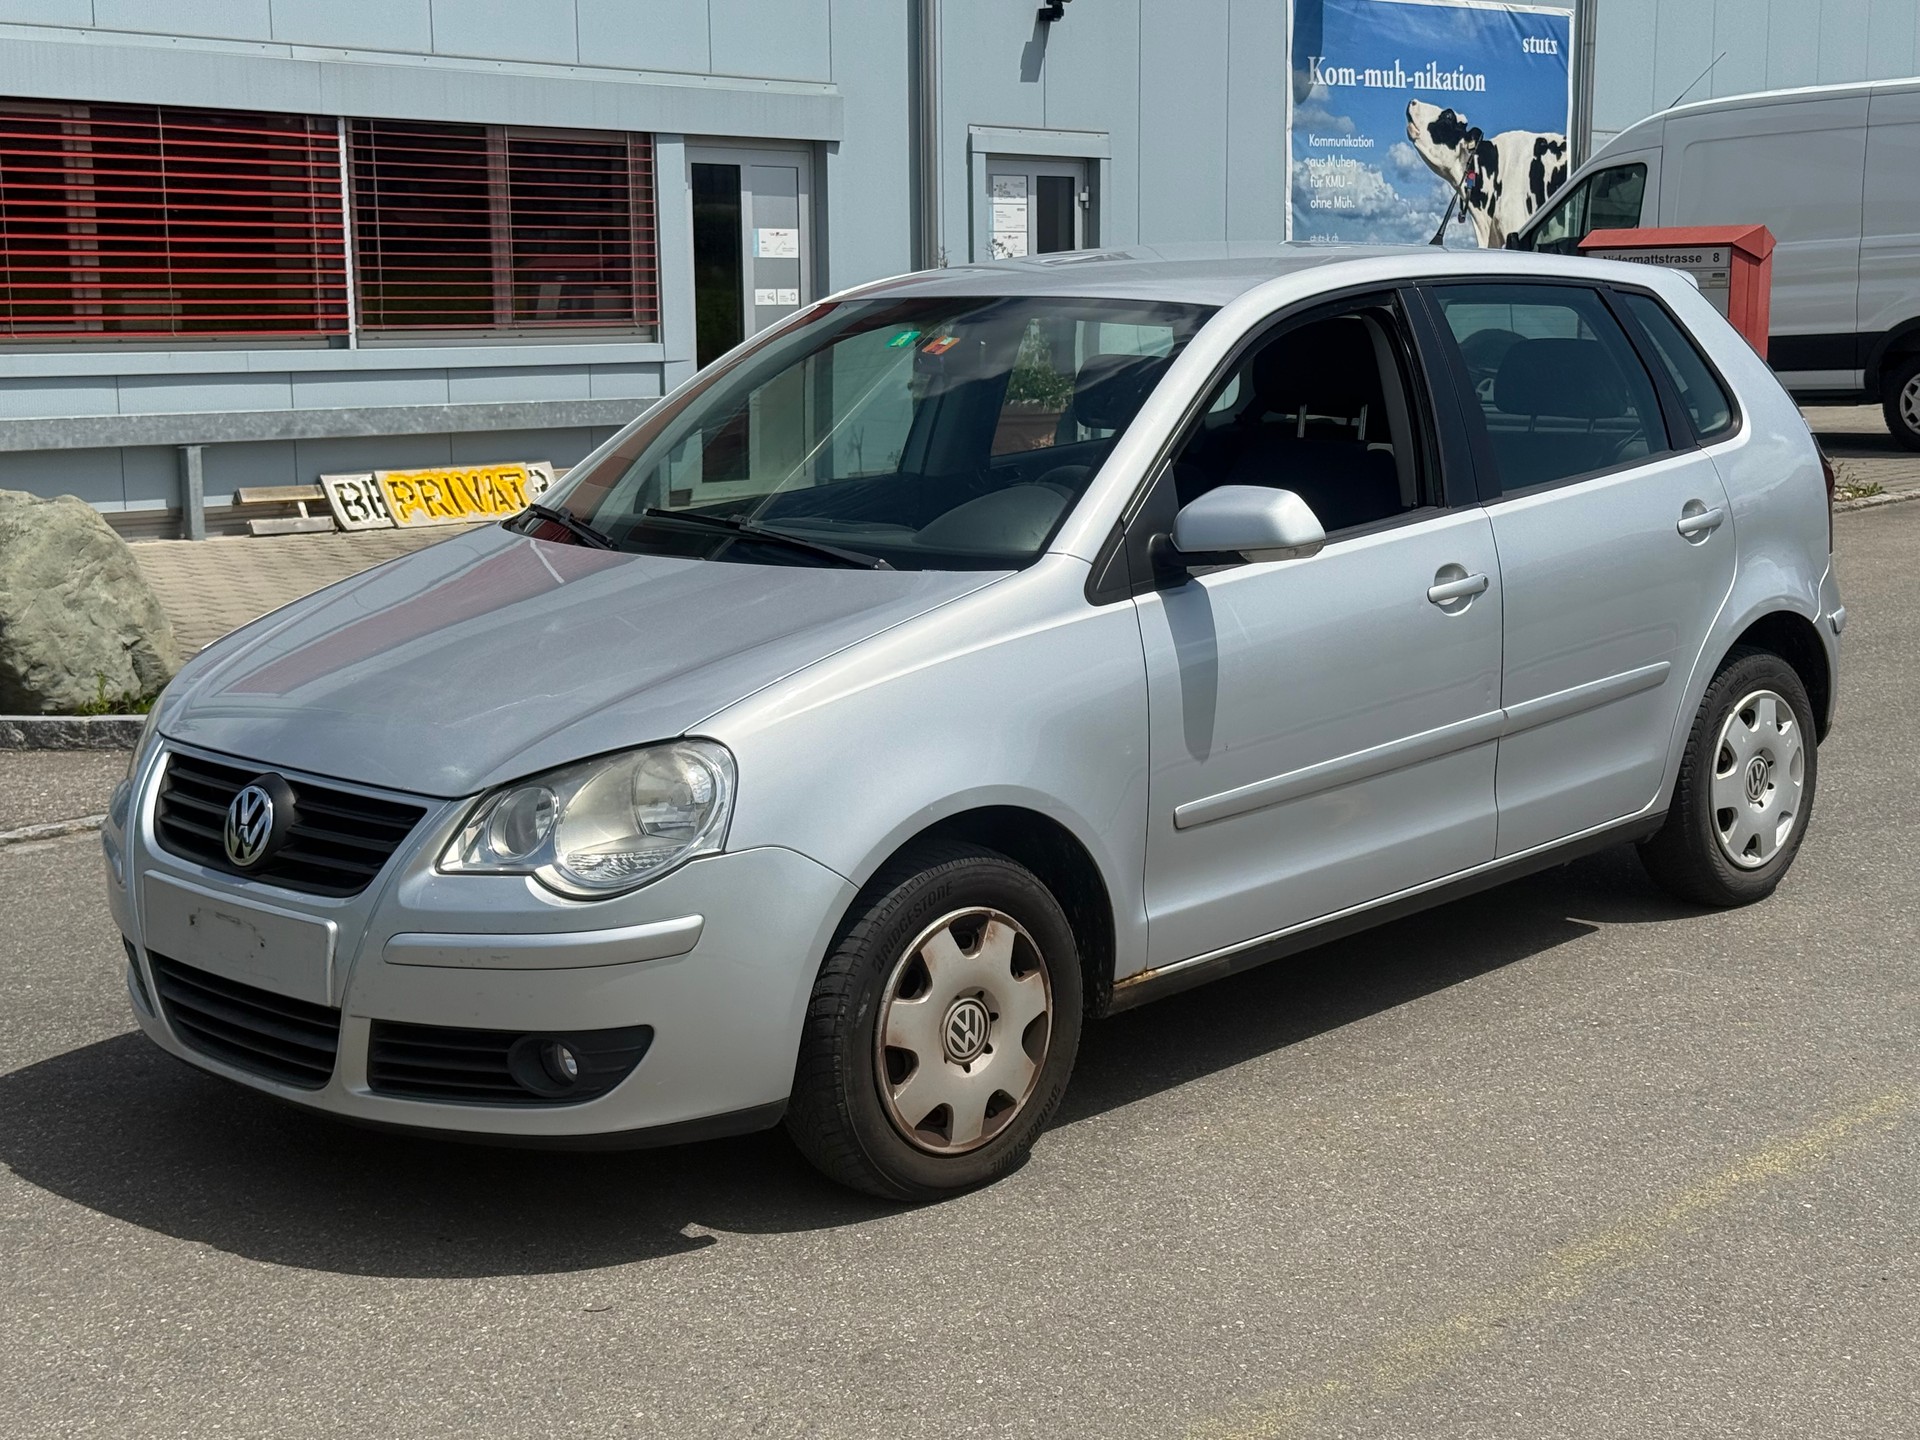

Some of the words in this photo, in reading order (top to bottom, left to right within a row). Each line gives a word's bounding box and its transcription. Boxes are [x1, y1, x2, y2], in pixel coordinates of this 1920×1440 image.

[1522, 35, 1558, 55] stutz
[1307, 56, 1486, 92] Kom-muh-nikation
[1309, 133, 1375, 148] Kommunikation
[1310, 158, 1326, 168] aus
[1328, 154, 1357, 168] Muhen
[1310, 174, 1324, 188] für
[1325, 175, 1346, 188] KMU
[1310, 195, 1332, 209] ohne
[1334, 195, 1356, 209] Müh.
[1712, 252, 1720, 263] 8
[387, 472, 528, 519] PRIVAT
[1746, 758, 1768, 800] VW
[224, 785, 273, 867] VW
[872, 880, 954, 974] BRIDGESTONE
[945, 1001, 986, 1060] VW
